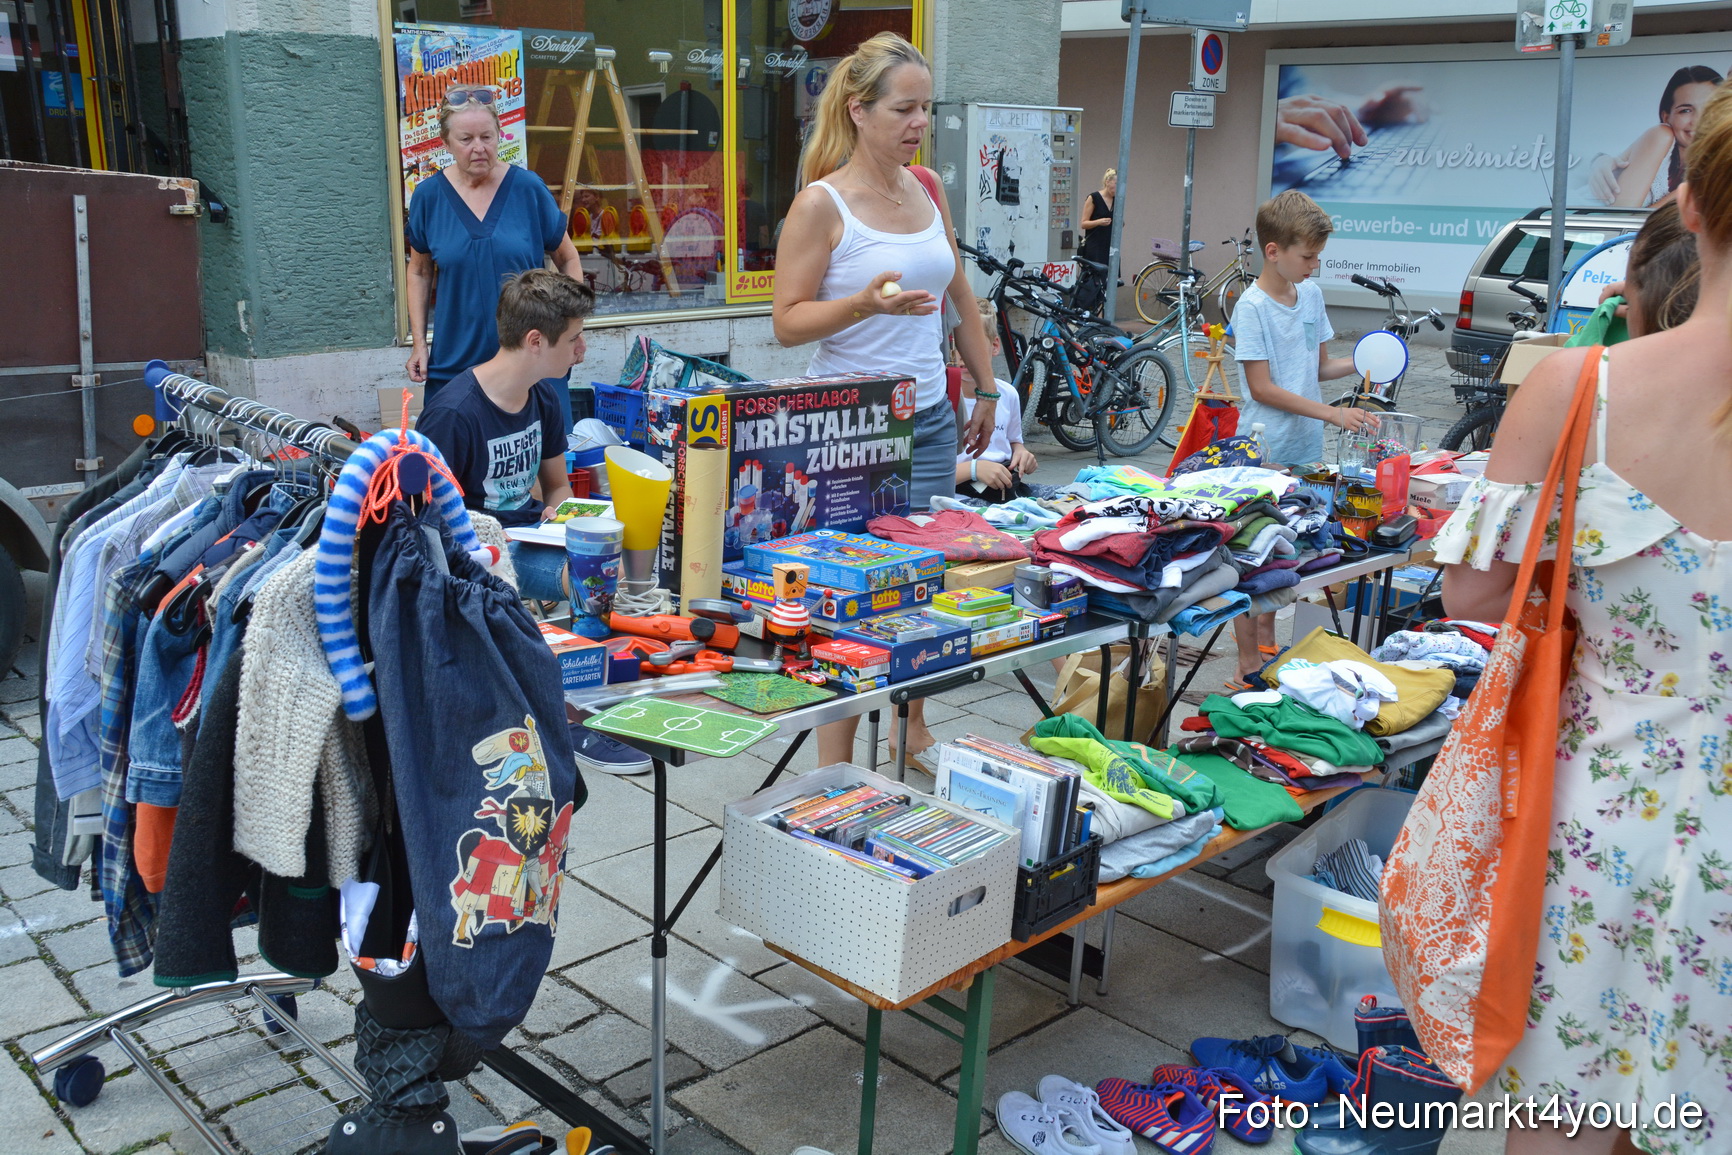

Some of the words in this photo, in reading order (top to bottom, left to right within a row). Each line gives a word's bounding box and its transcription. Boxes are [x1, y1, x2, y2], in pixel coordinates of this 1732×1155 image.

[531, 35, 588, 63] Davidoff
[422, 49, 452, 75] Open
[764, 51, 809, 78] Davidoff
[1202, 77, 1220, 88] ZONE
[1393, 147, 1432, 167] zu
[1332, 214, 1423, 236] Gewerbe-
[1429, 218, 1469, 237] und
[1325, 259, 1364, 271] Gloßner
[1366, 261, 1421, 274] Immobilien
[1582, 269, 1618, 285] Pelz-
[735, 388, 860, 417] FORSCHERLABOR
[895, 386, 915, 409] 50
[734, 403, 889, 453] KRISTALLE
[493, 428, 539, 460] HILFIGER
[805, 434, 912, 475] ZÜCHTEN
[489, 444, 539, 480] DENIM
[500, 479, 519, 490] NEW
[714, 486, 726, 516] Mikado
[1409, 493, 1432, 504] Miele
[753, 534, 819, 550] HARIBO
[915, 563, 945, 577] Puzzle
[919, 555, 939, 569] HARIBO
[1506, 750, 1518, 813] MANGO
